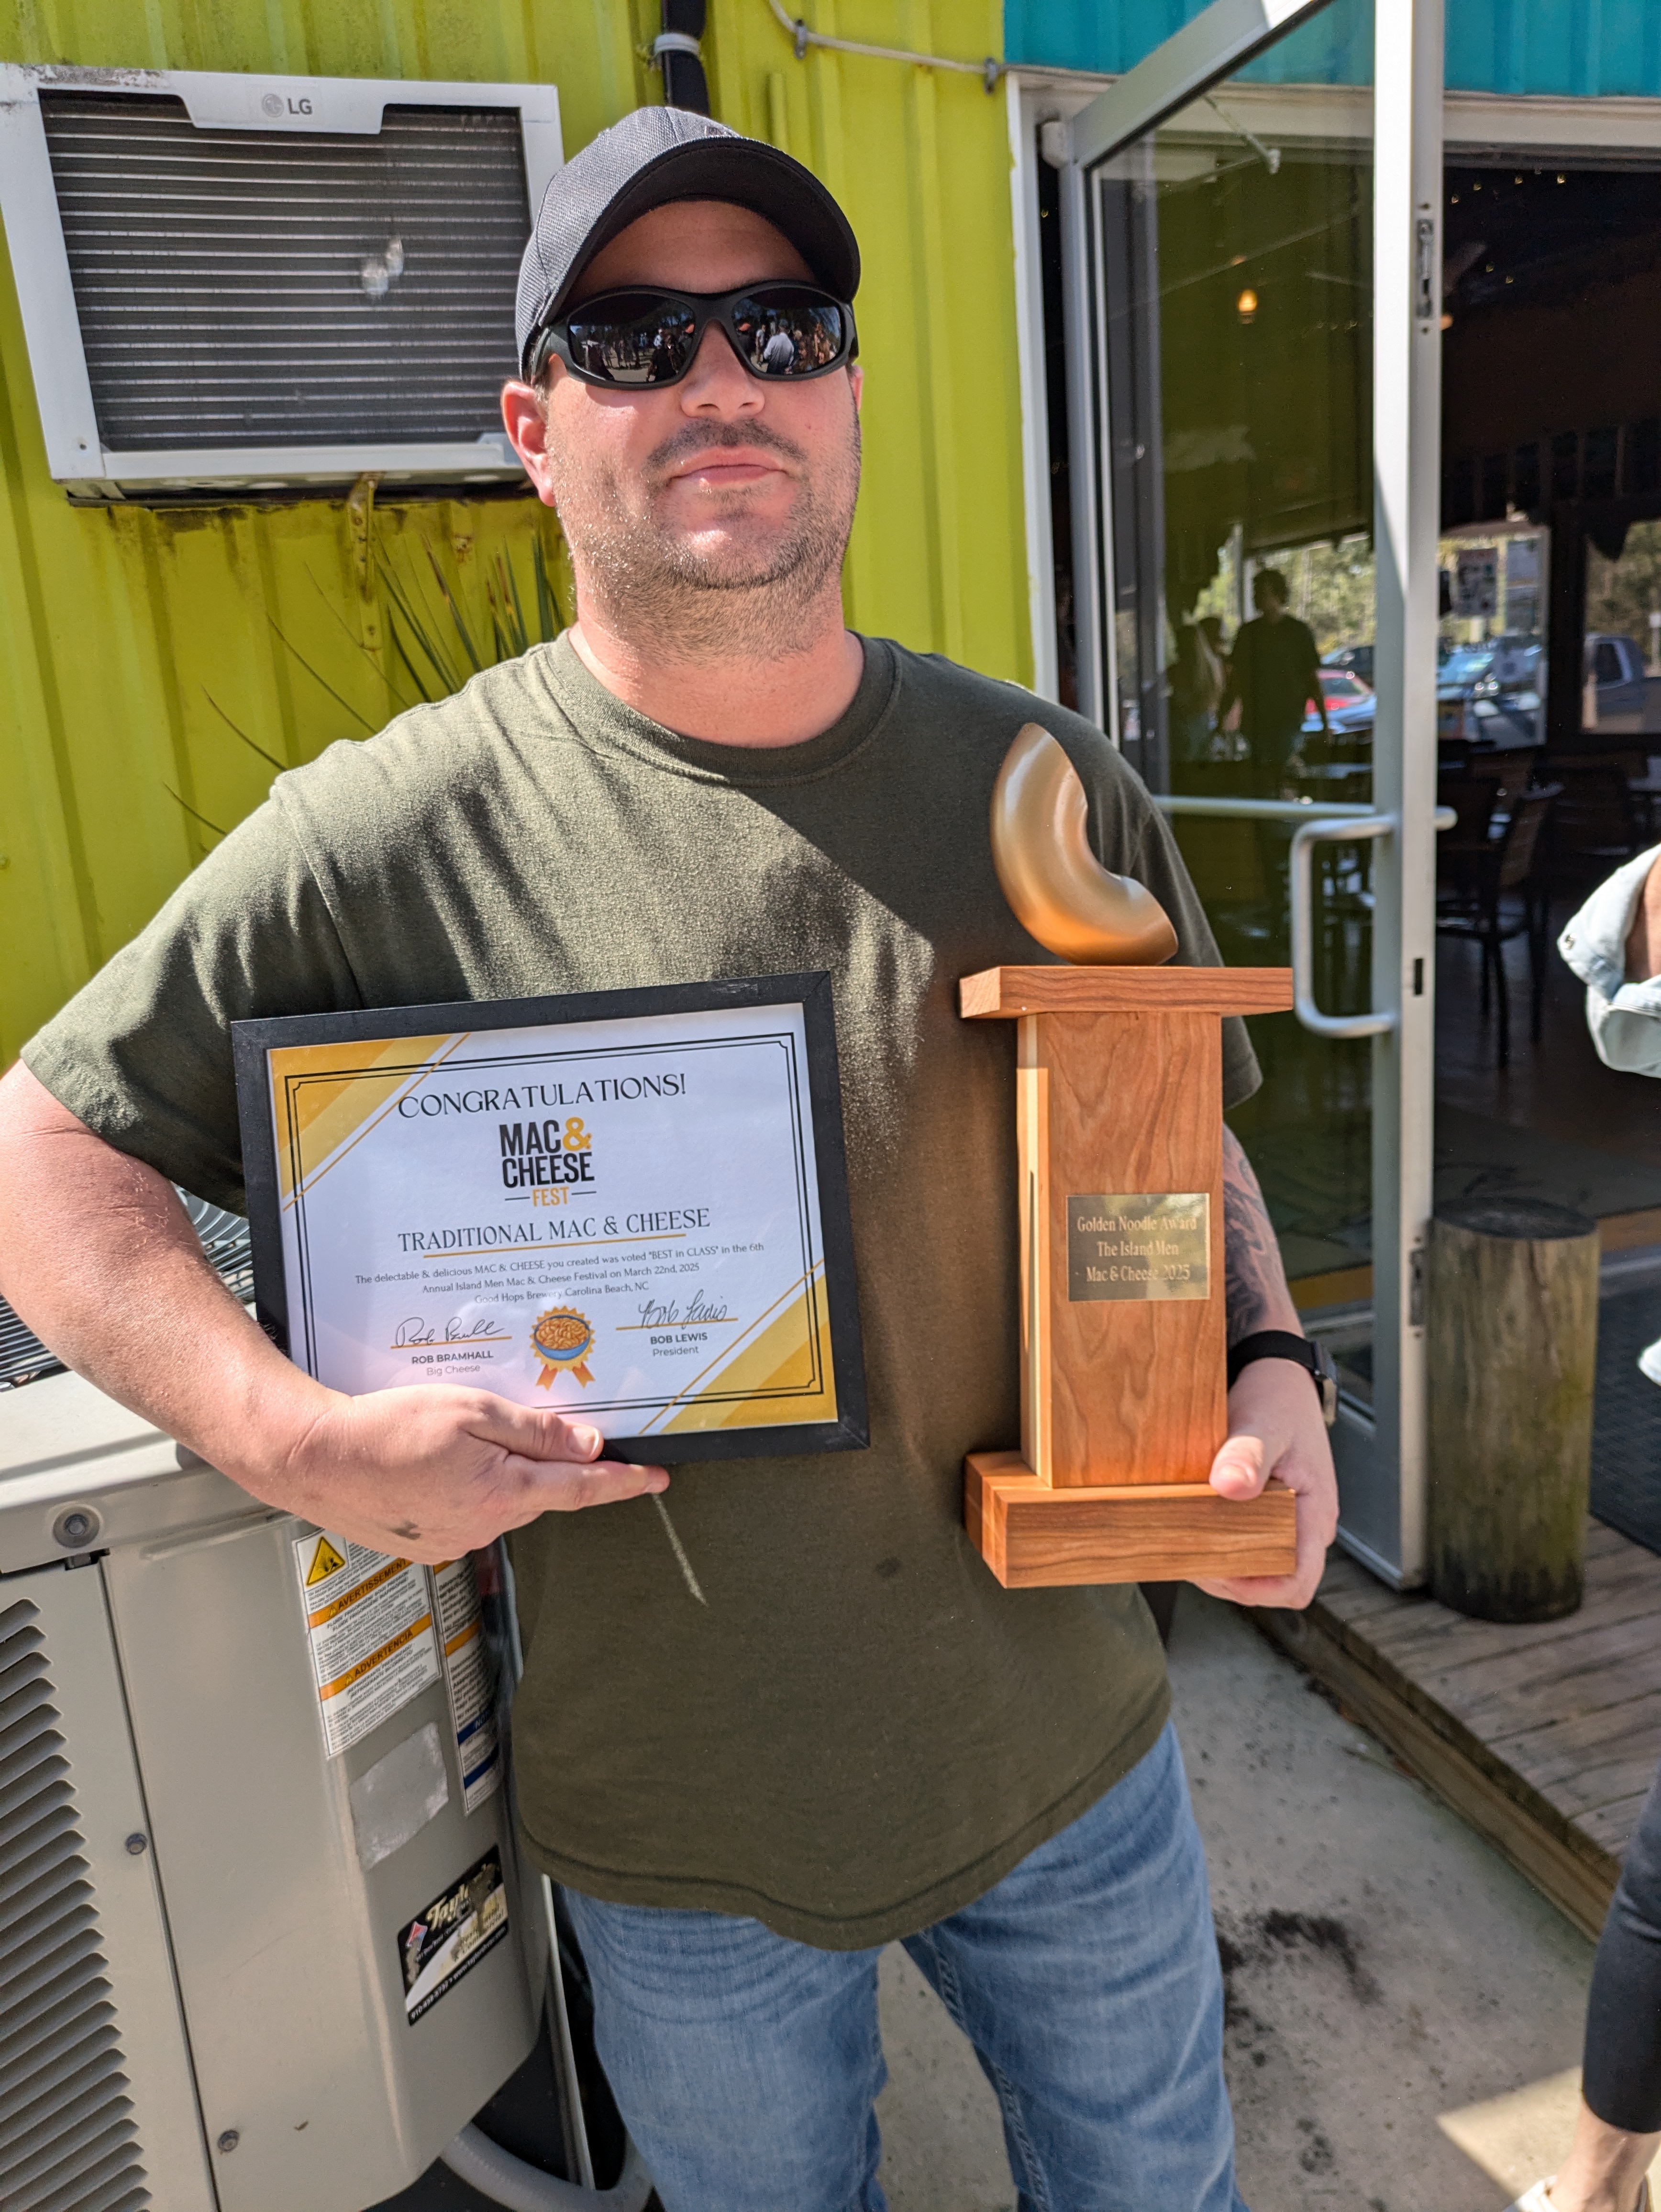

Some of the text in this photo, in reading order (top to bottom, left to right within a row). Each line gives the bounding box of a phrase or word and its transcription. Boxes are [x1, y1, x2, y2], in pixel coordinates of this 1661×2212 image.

[288, 98, 313, 115] LG
[398, 1073, 686, 1118] CONGRATULATIONS!
[501, 1152, 595, 1188] CHEESE
[532, 1186, 569, 1207] FEST
[398, 1208, 711, 1252] TRADITIONAL MAC & CHEESE
[1077, 1216, 1197, 1232] Golden Noodle Award
[1097, 1240, 1179, 1257] The Island Men
[355, 1274, 372, 1284] The
[375, 1271, 420, 1283] delectable
[422, 1270, 430, 1279] &
[433, 1267, 472, 1278] delicious
[475, 1264, 497, 1274] MAC
[499, 1263, 507, 1272] &
[510, 1260, 545, 1271] CHEESE
[548, 1260, 564, 1271] you
[566, 1256, 599, 1267] created
[602, 1255, 619, 1263] was
[622, 1252, 646, 1261] voted
[675, 1250, 684, 1258] in
[721, 1246, 730, 1254] in
[732, 1244, 747, 1253] the
[750, 1242, 764, 1251] 6th
[1085, 1264, 1190, 1282] Mac & Cheese 2025
[422, 1283, 454, 1293] Annual
[456, 1281, 482, 1291] Island
[485, 1279, 504, 1288] Men
[507, 1277, 525, 1286] Mac
[538, 1272, 572, 1284] Cheese
[574, 1270, 608, 1281] Festival
[610, 1270, 621, 1278] on
[624, 1266, 652, 1277] March
[654, 1264, 677, 1275] 22nd,
[679, 1263, 700, 1272] 2025
[474, 1281, 649, 1304] Good Hops Brewery Carolina Beach, NC
[650, 1332, 708, 1345] BOB LEWIS
[412, 1350, 494, 1364] ROB BRAMHALL
[653, 1345, 699, 1357] President
[427, 1365, 481, 1376] Big Cheese
[338, 1558, 407, 1610] AVERTISSEMENT
[354, 1628, 414, 1677] ADVERTENCIA
